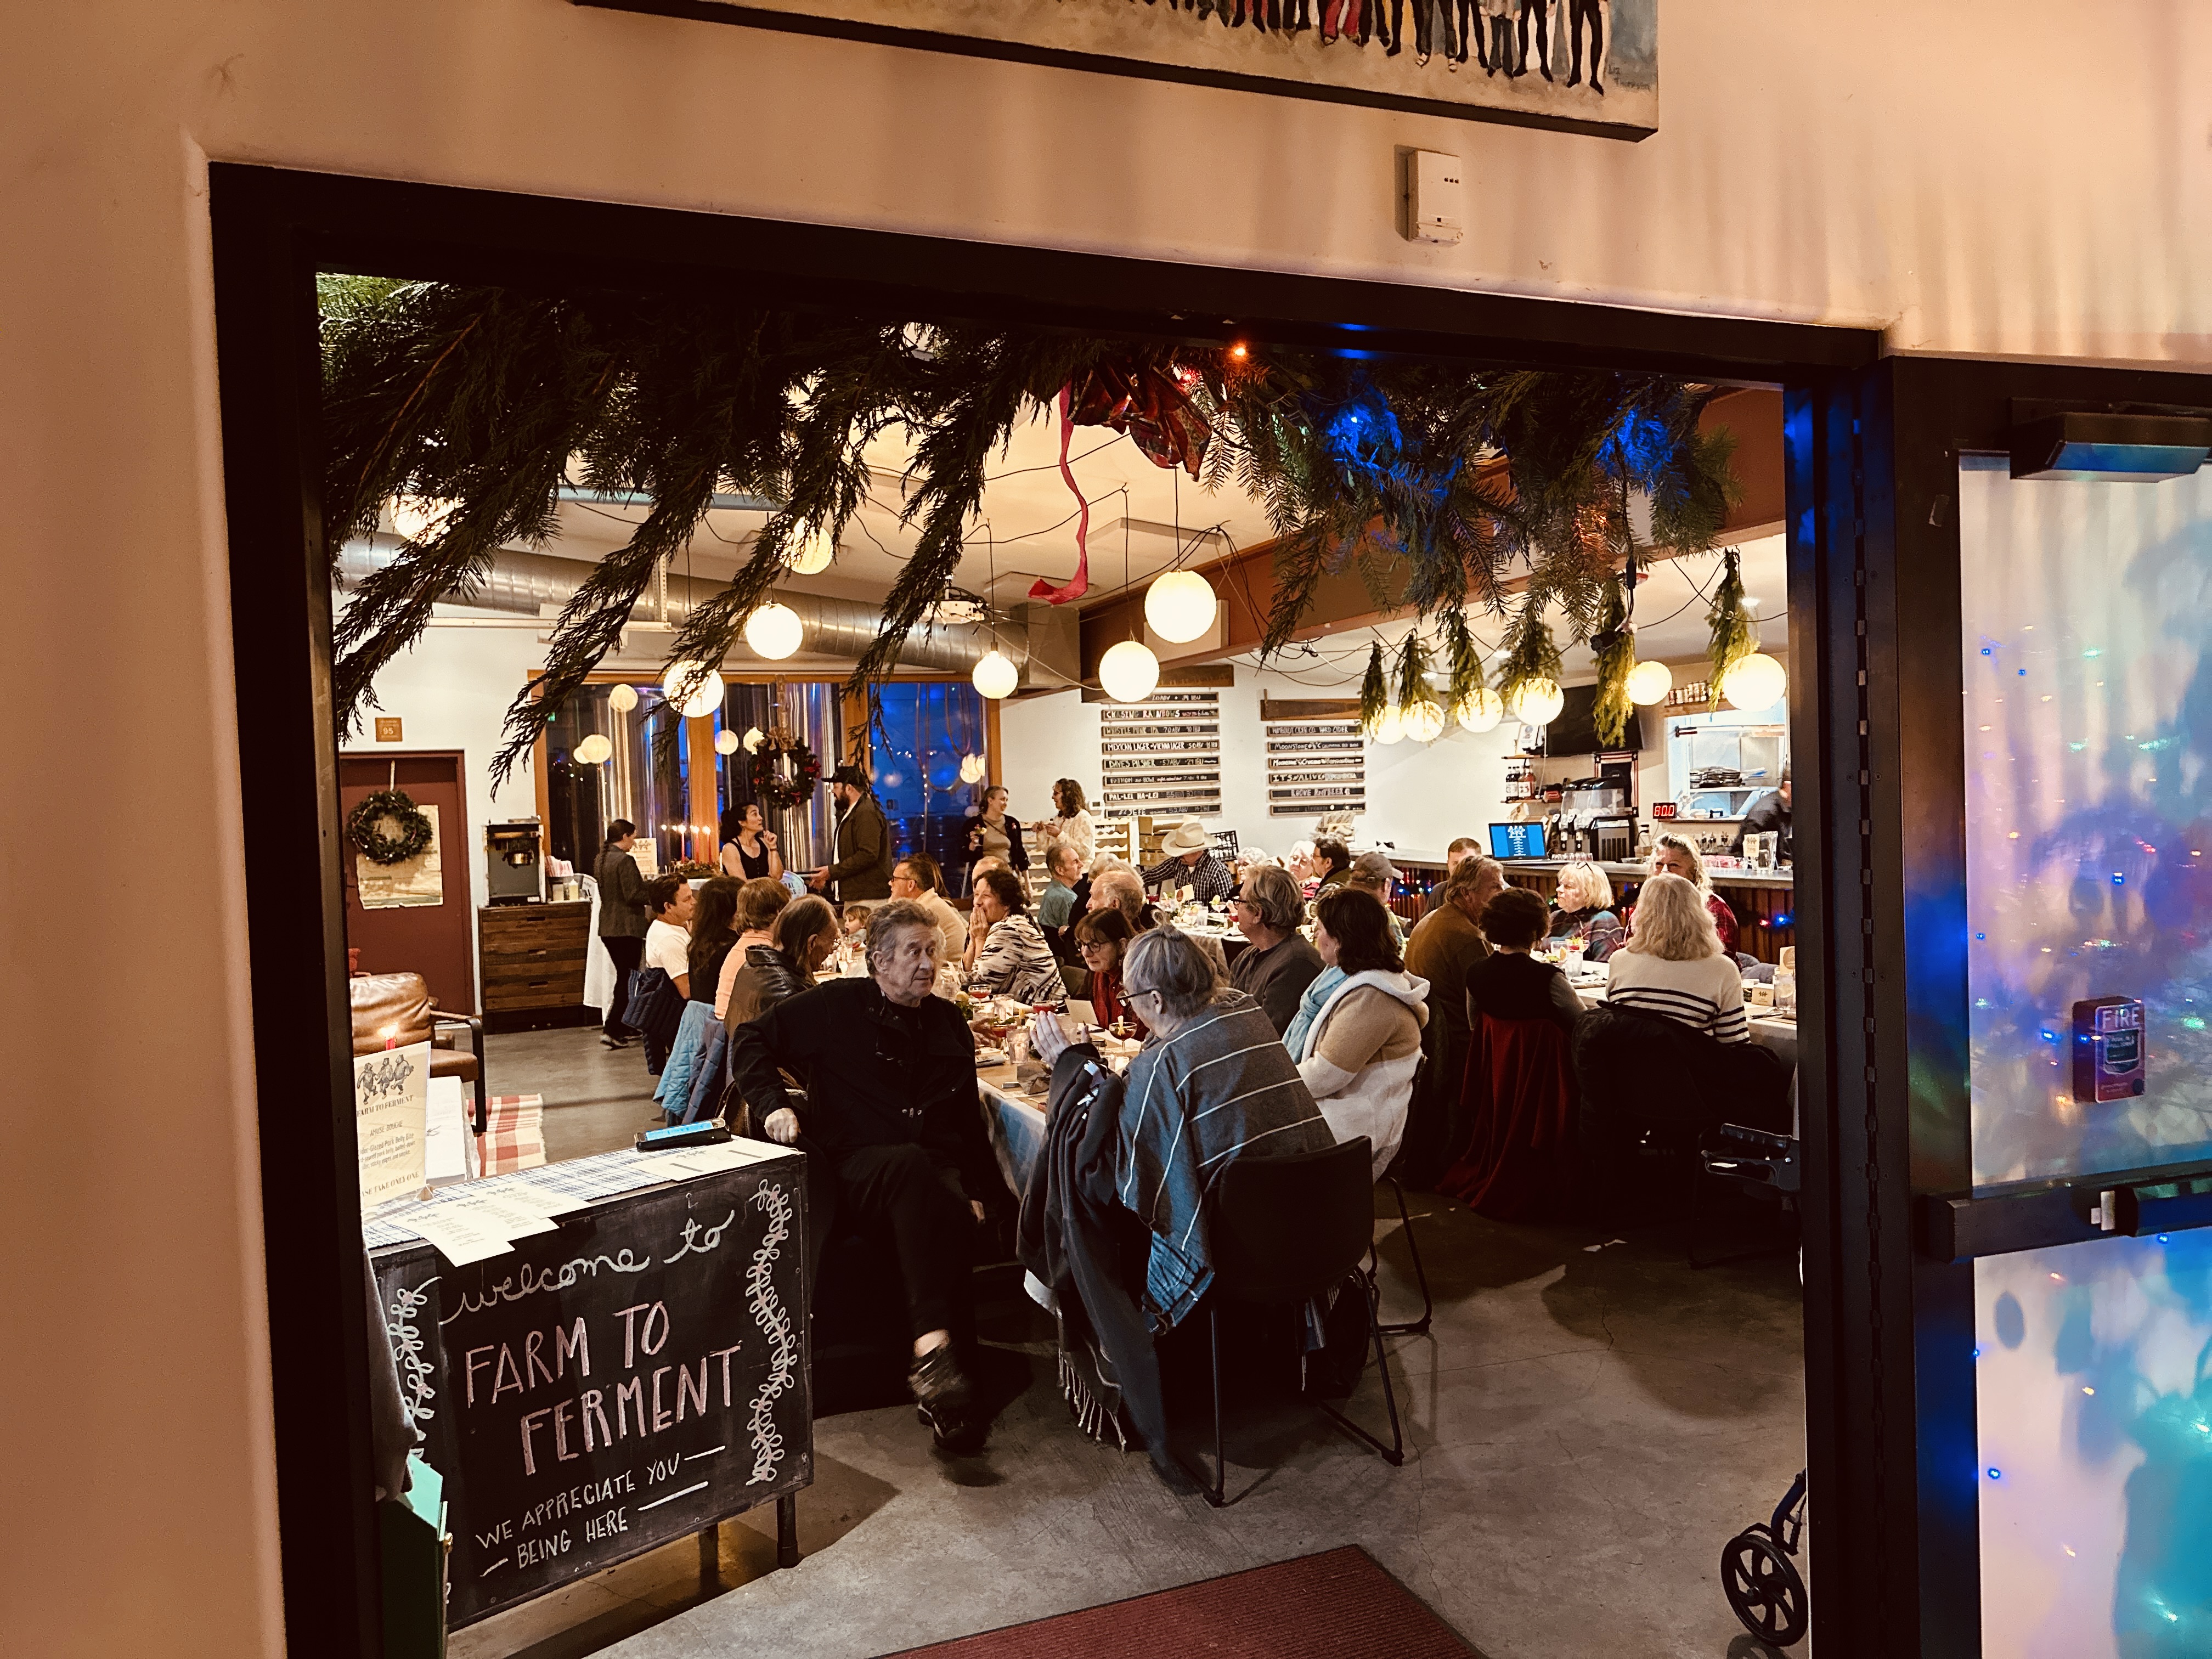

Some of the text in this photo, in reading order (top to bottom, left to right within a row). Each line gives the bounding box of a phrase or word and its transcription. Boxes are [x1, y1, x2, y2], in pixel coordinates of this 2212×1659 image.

[1106, 710, 1139, 718] CHASING
[1142, 709, 1180, 718] RAINBOWS
[1106, 726, 1131, 735] WHISTLE
[1133, 742, 1150, 751] LAGER
[1132, 759, 1156, 768] PILSNER
[2102, 1007, 2140, 1029] FIRE
[357, 1106, 374, 1117] FARM
[385, 1095, 413, 1109] FERMENT
[370, 1120, 403, 1136] AMUSE BOUCHE
[360, 1142, 384, 1155] ider-Glazed
[374, 1181, 390, 1193] TAKE
[390, 1176, 405, 1187] ONLY
[407, 1171, 420, 1181] ONE
[439, 1209, 736, 1325] welcome to
[465, 1301, 670, 1409] FARM TO
[520, 1340, 744, 1476] FERMENT
[475, 1452, 680, 1549] WE APPRECIATE YOU
[517, 1506, 629, 1570] BEING HERE
